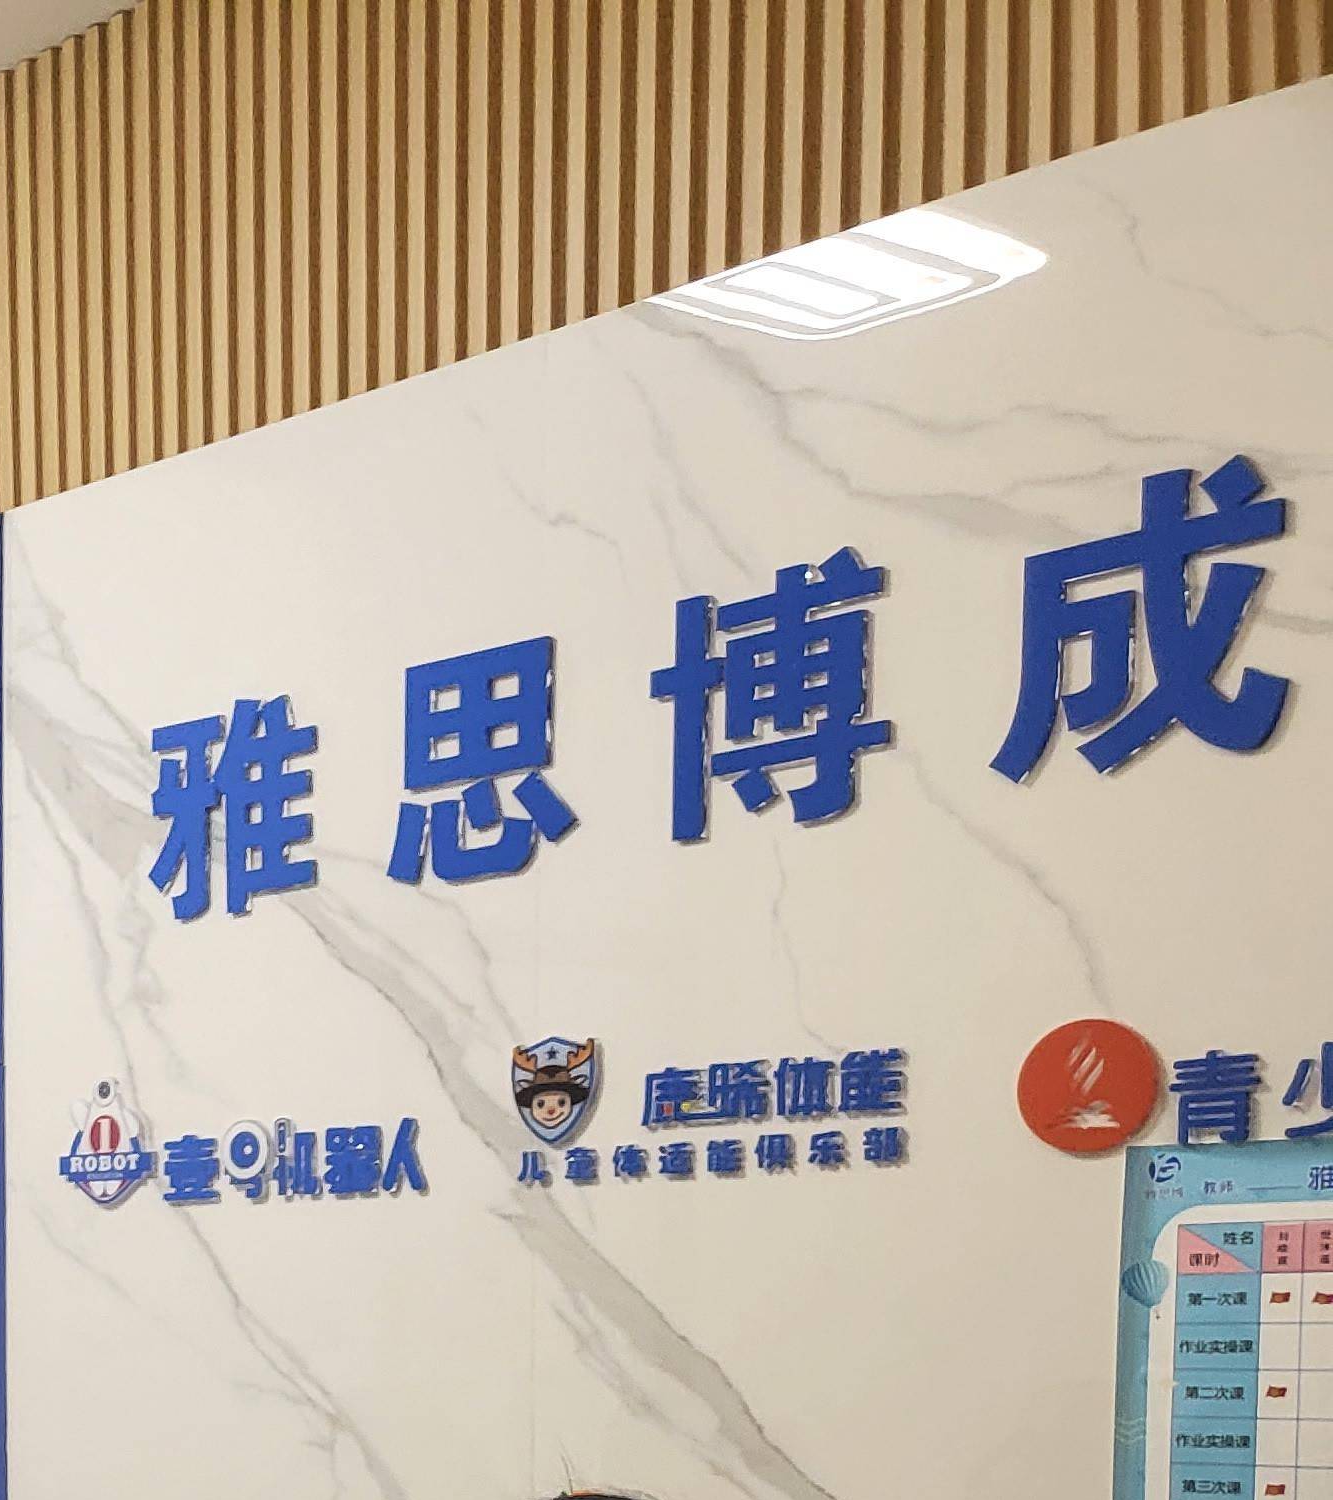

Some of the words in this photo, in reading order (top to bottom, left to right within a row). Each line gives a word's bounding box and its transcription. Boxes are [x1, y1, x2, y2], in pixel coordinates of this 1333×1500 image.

[147, 454, 1291, 922] 雅思博成
[163, 1117, 428, 1199] 壹号机器人
[518, 1127, 901, 1182] 儿童体适能俱乐部
[70, 1153, 140, 1173] ROBOT
[1223, 1231, 1254, 1245] 姓名
[1189, 1253, 1219, 1267] 课时
[1188, 1292, 1247, 1306] 第一次课
[1185, 1386, 1245, 1400] 第二次课
[1182, 1480, 1242, 1495] 第三次课
